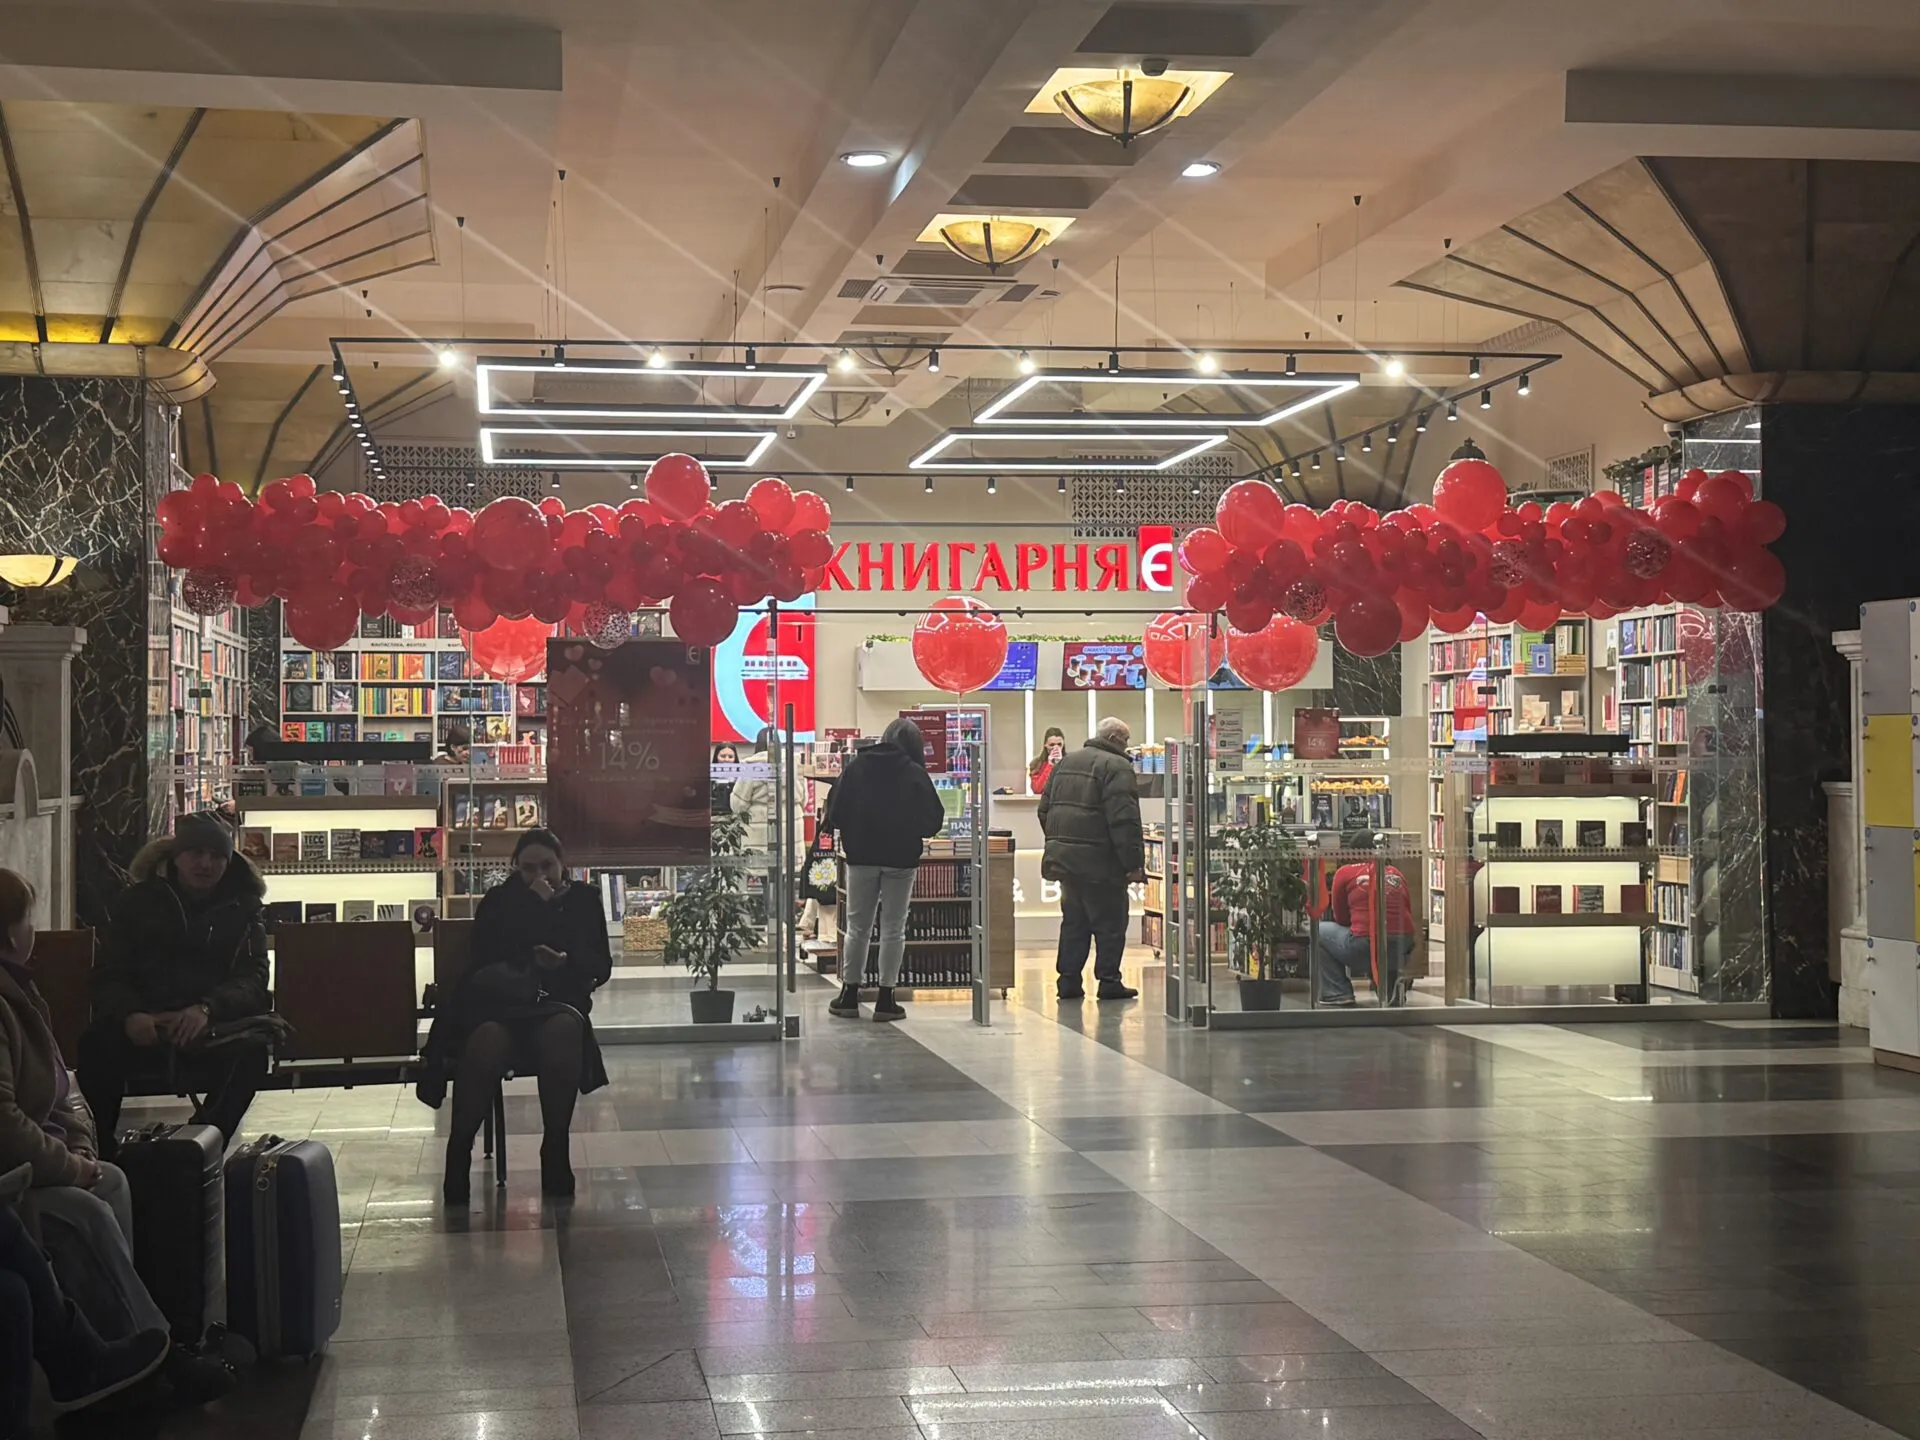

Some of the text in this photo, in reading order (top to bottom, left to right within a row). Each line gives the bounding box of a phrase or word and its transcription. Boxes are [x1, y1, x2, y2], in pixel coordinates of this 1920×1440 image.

[821, 541, 1174, 593] КНИГАРНЯ Є
[598, 741, 660, 770] 14%
